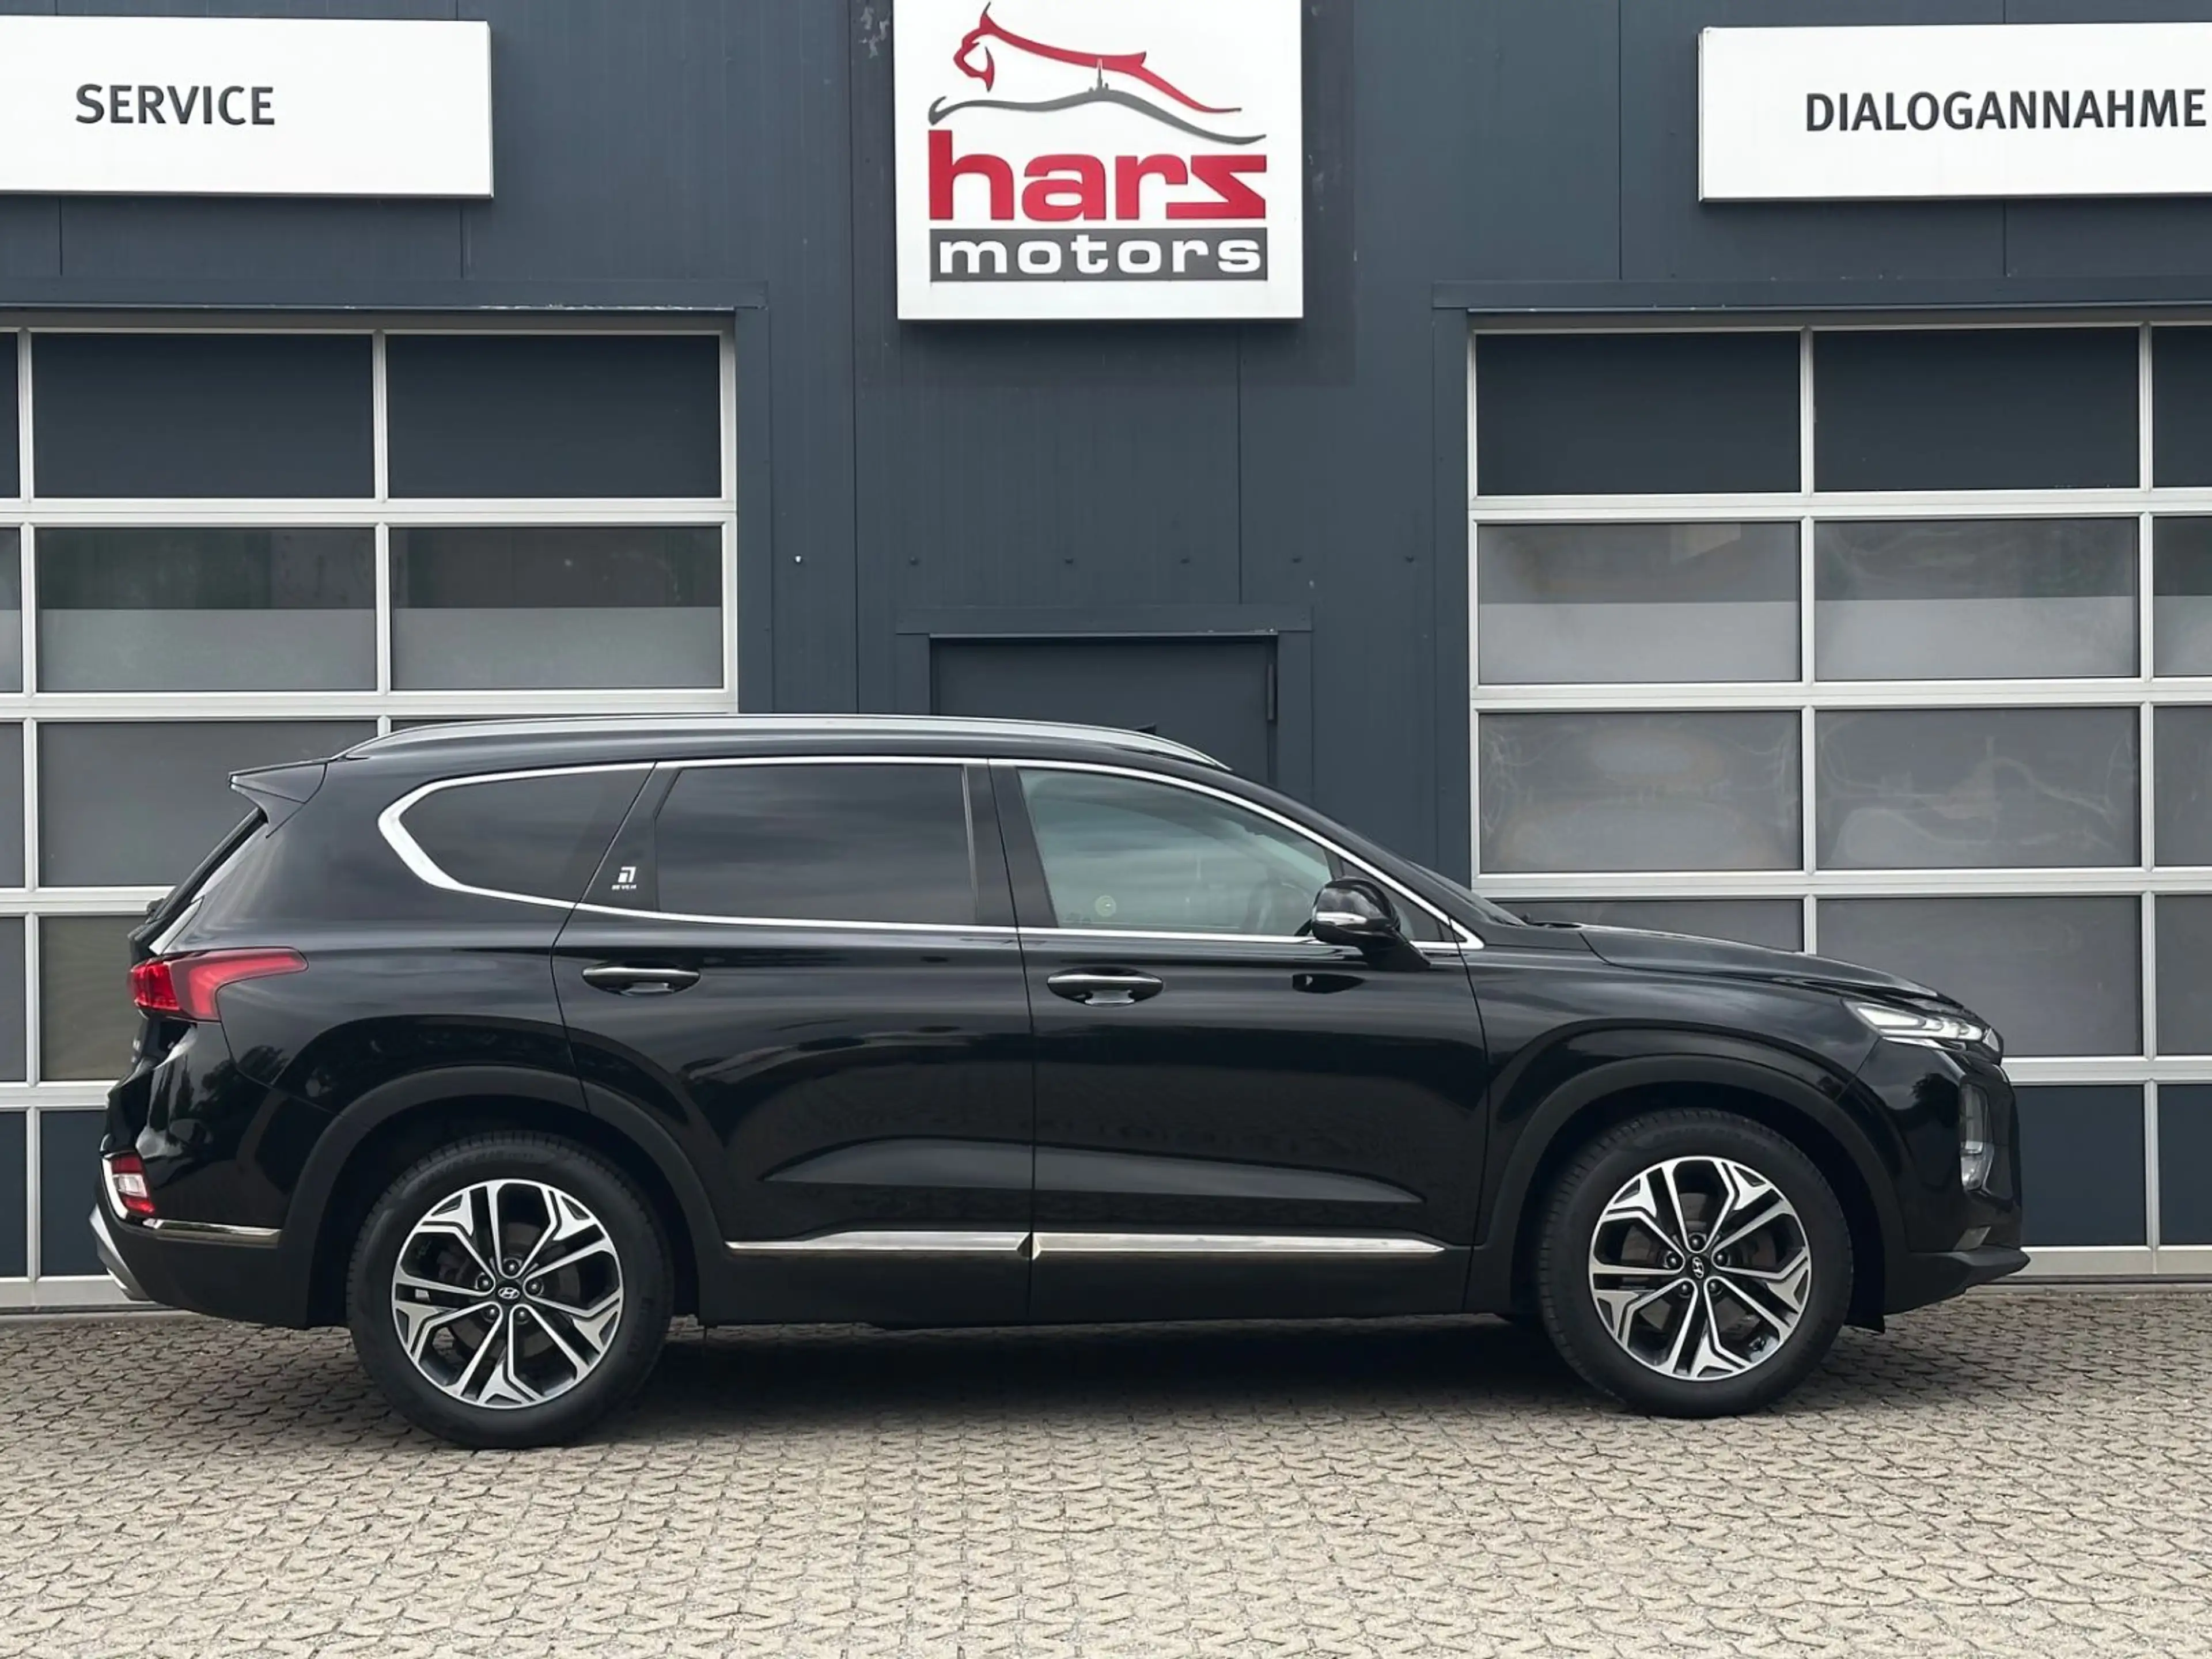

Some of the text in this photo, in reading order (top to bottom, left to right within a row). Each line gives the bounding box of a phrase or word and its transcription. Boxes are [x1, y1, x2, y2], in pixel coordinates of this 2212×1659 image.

[75, 84, 275, 126] SERVICE
[1806, 89, 2206, 131] DIALOGANNAHME
[940, 234, 1260, 274] motors
